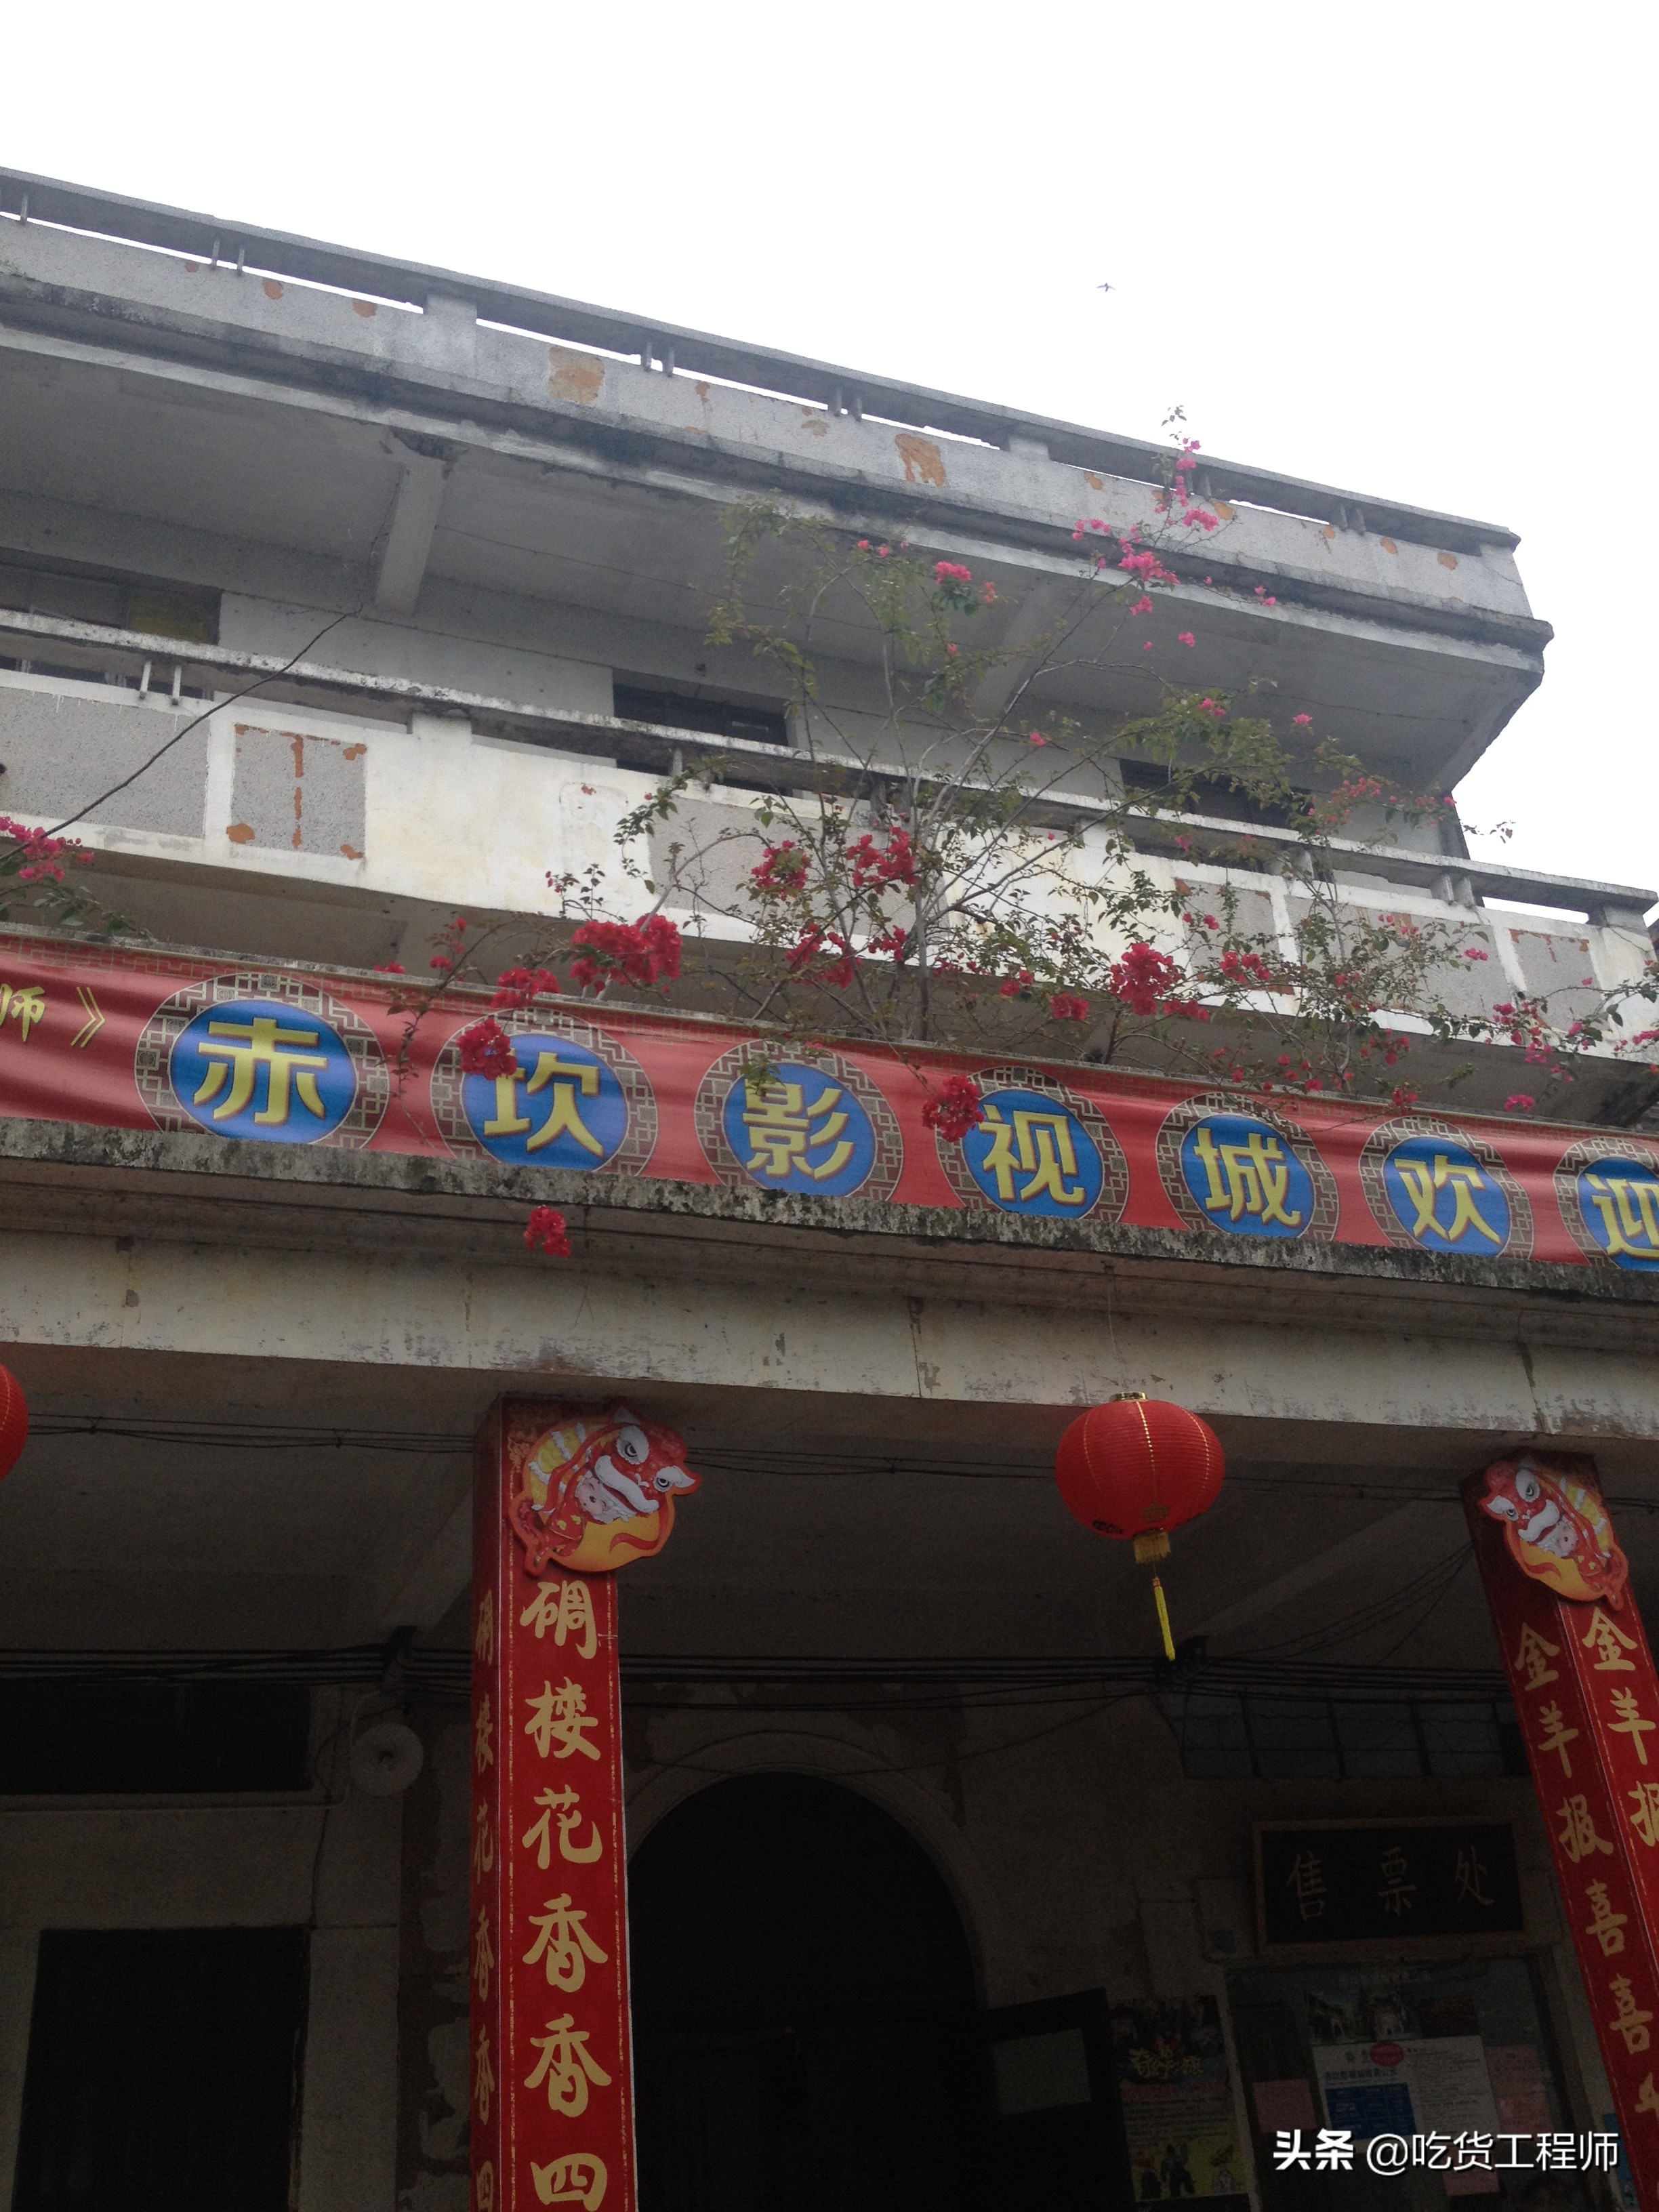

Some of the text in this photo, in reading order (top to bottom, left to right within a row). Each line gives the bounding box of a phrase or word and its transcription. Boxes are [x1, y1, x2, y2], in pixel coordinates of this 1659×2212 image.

[519, 1580, 613, 2212] 碉楼花香香四
[1287, 1845, 1496, 1922] 售票处
